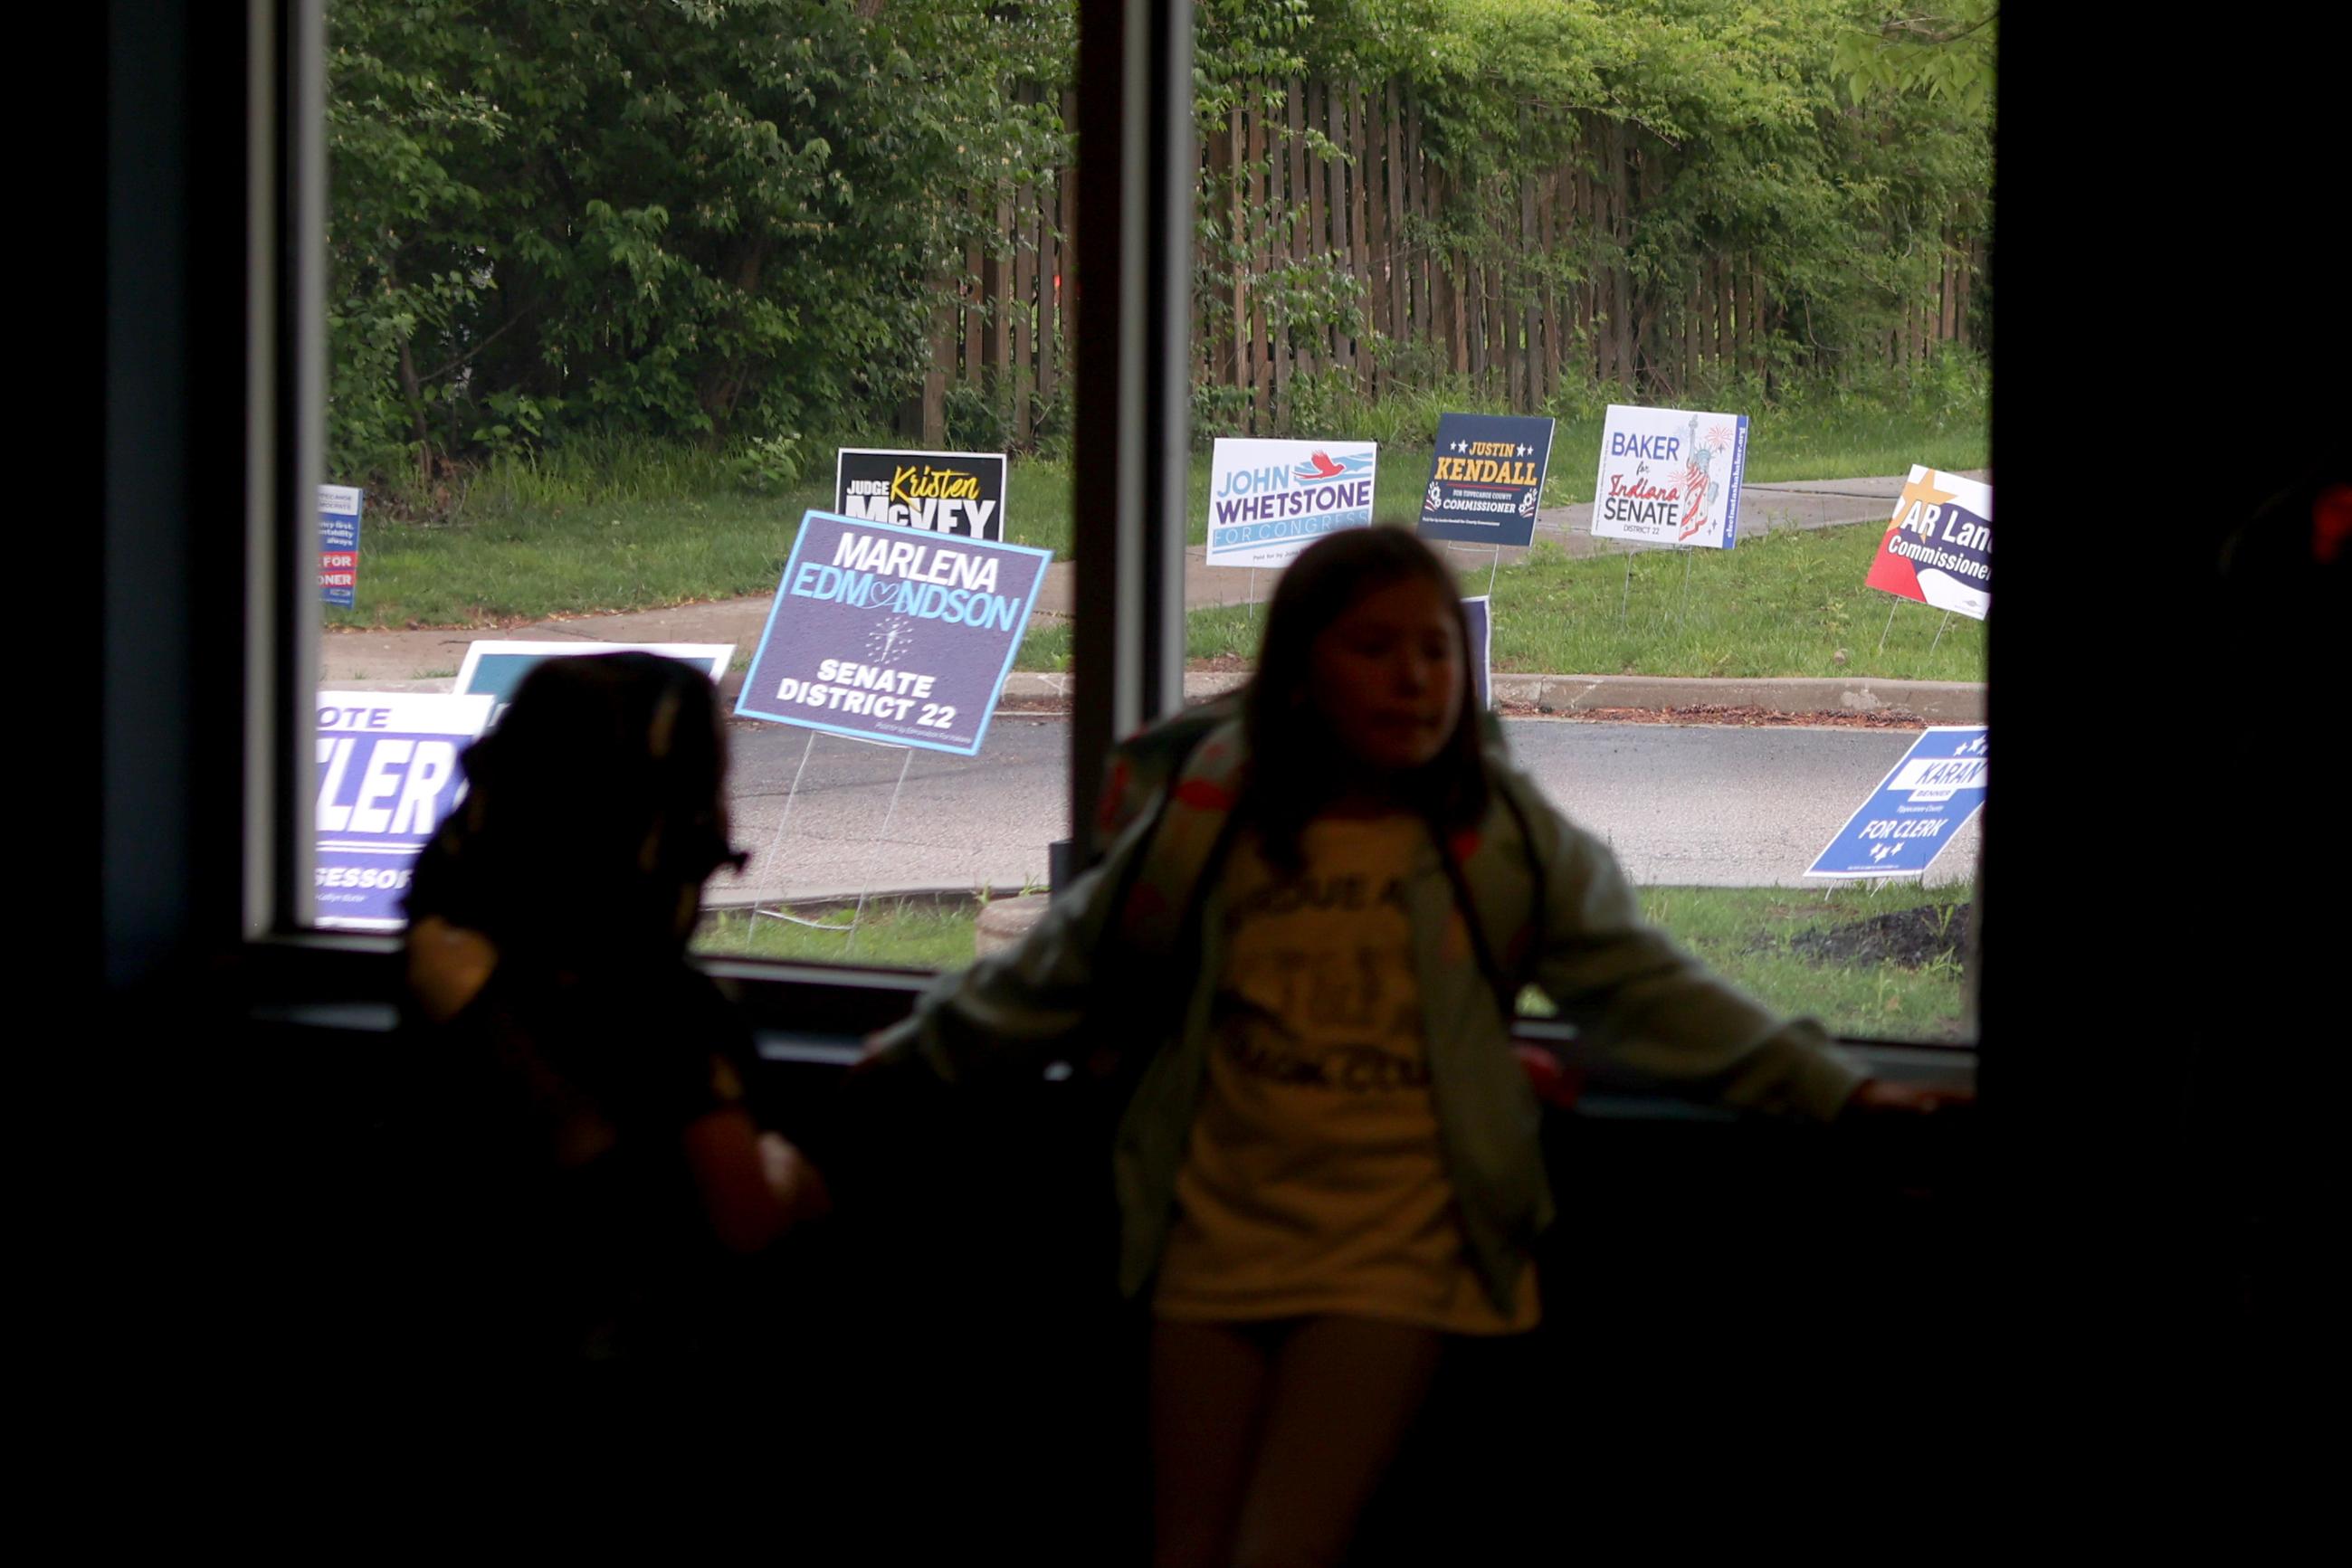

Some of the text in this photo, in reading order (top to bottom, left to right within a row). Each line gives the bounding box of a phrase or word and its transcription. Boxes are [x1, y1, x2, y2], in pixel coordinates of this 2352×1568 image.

[1468, 442, 1515, 458] JUSTIN
[1612, 432, 1680, 461] BAKER
[1217, 464, 1290, 498] JOHN
[1435, 457, 1538, 486] KENDALL
[1636, 461, 1651, 475] for
[846, 480, 890, 496] JUDGE
[890, 465, 979, 512] Kristen
[1609, 474, 1680, 501] Indiana
[1215, 480, 1372, 526] WHETSTONE
[1443, 499, 1516, 513] COMMISSIONER
[1604, 498, 1679, 527] SENATE
[1213, 509, 1370, 546] FOR CONGRESS
[1623, 525, 1660, 535] DISTRICT 22
[1900, 499, 1942, 538] AR
[323, 556, 351, 566] FOR
[833, 532, 1000, 594] MARLENA
[817, 659, 936, 698] SENATE
[776, 678, 956, 729] DISTRICT 22
[316, 736, 456, 835] LER
[1915, 762, 1988, 785] KARAN
[1858, 819, 1949, 840] FOR CLERK
